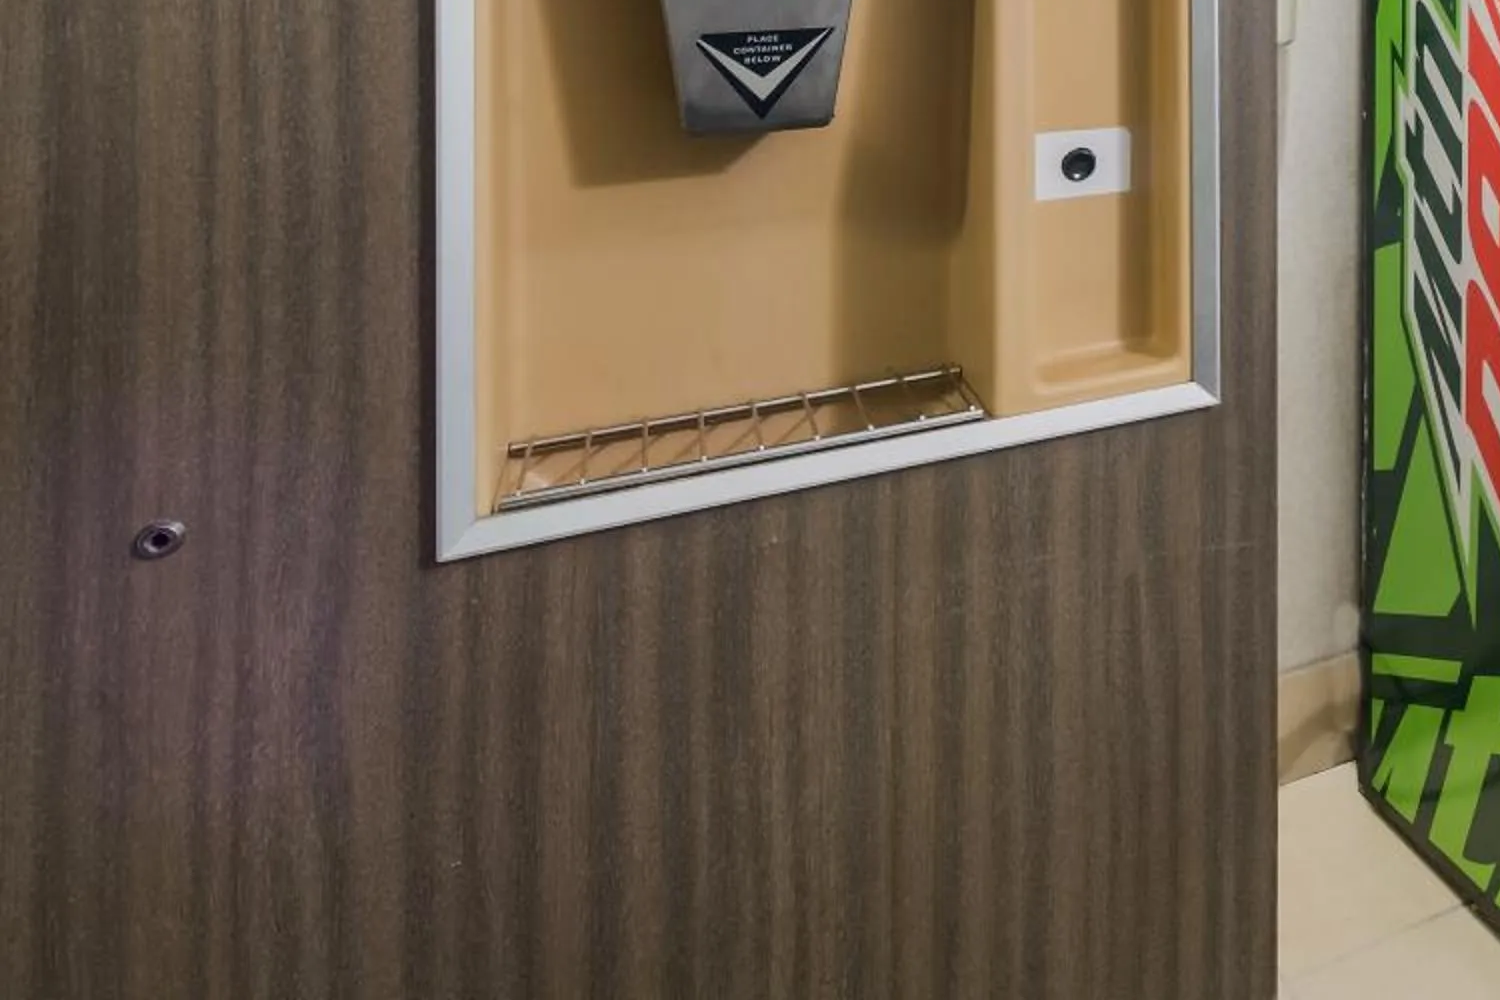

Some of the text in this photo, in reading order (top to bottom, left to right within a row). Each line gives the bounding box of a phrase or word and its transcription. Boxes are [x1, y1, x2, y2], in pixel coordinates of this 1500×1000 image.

[747, 35, 778, 43] PLACE
[734, 44, 793, 55] CONTAINER
[745, 55, 781, 65] BELOW
